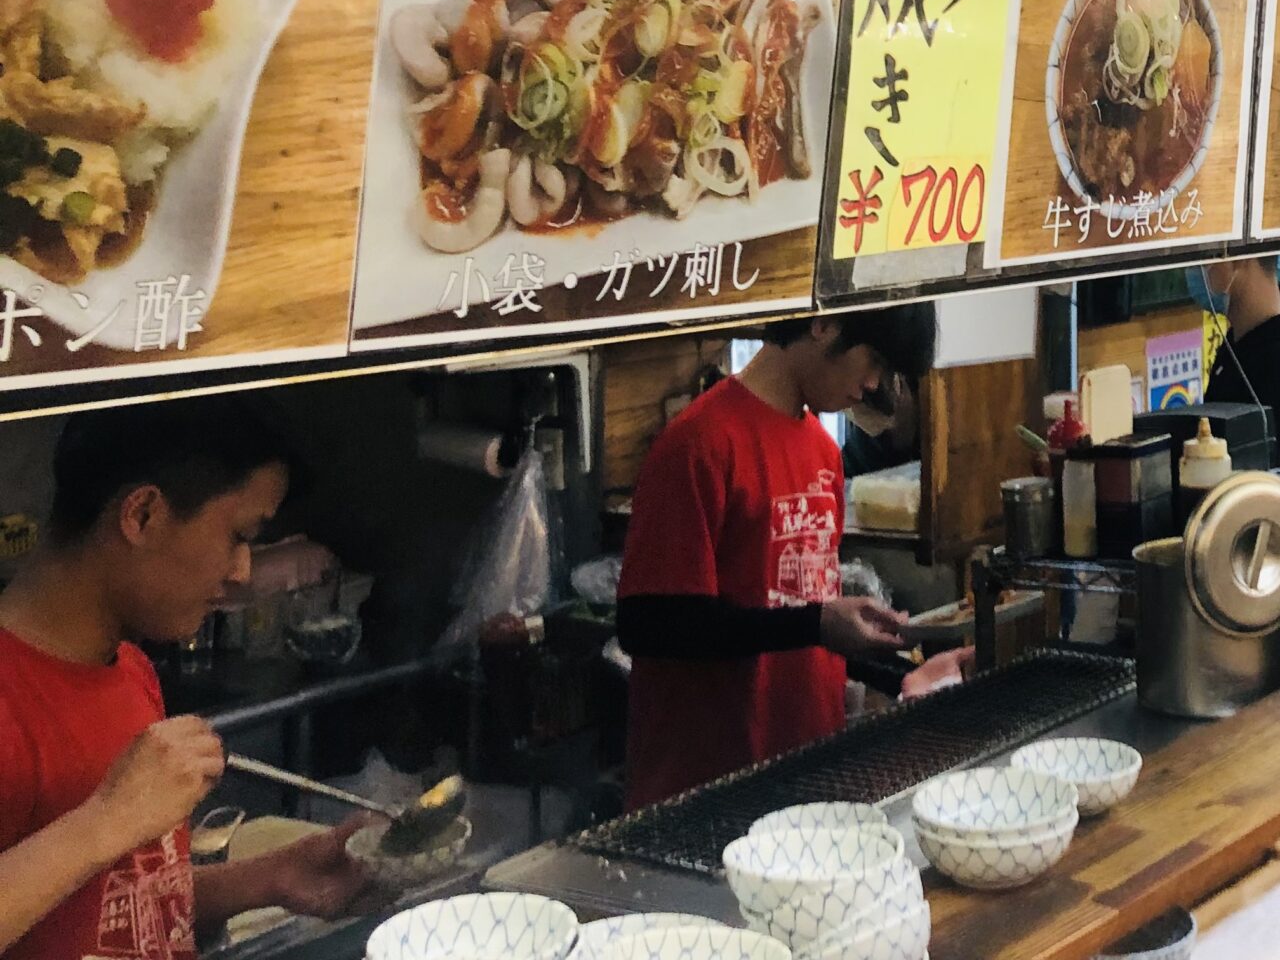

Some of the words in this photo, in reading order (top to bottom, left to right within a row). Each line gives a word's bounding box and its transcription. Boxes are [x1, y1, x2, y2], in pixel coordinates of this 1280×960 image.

[839, 163, 985, 253] ¥700
[1041, 187, 1204, 248] 牛すじ煮込み
[0, 274, 206, 362] ポン酢
[437, 241, 760, 319] 小袋・ガツ刺し
